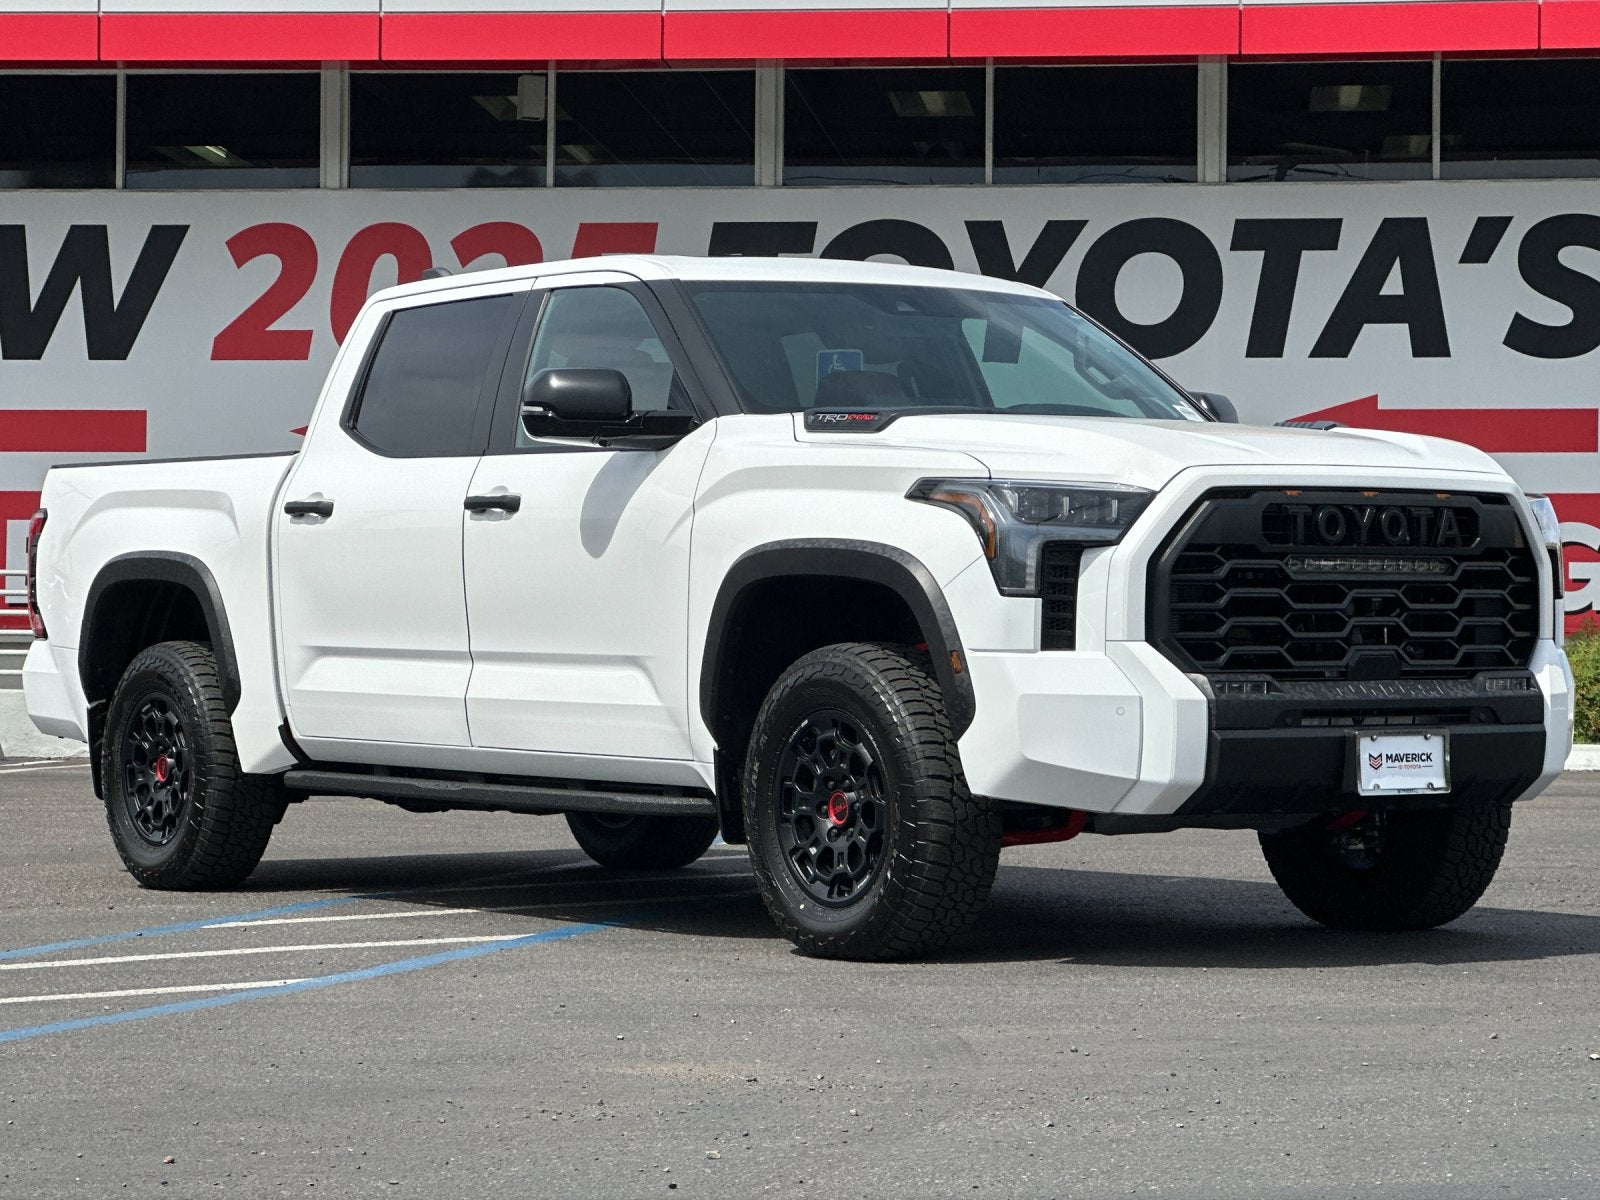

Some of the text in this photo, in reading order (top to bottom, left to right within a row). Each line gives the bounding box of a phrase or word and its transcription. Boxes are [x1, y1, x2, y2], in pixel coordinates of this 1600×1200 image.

[210, 221, 659, 361] 20
[708, 213, 1600, 363] YOTA'S
[817, 413, 848, 423] TRD
[1283, 505, 1463, 547] TOYOTA
[1385, 752, 1433, 763] MAVERICK
